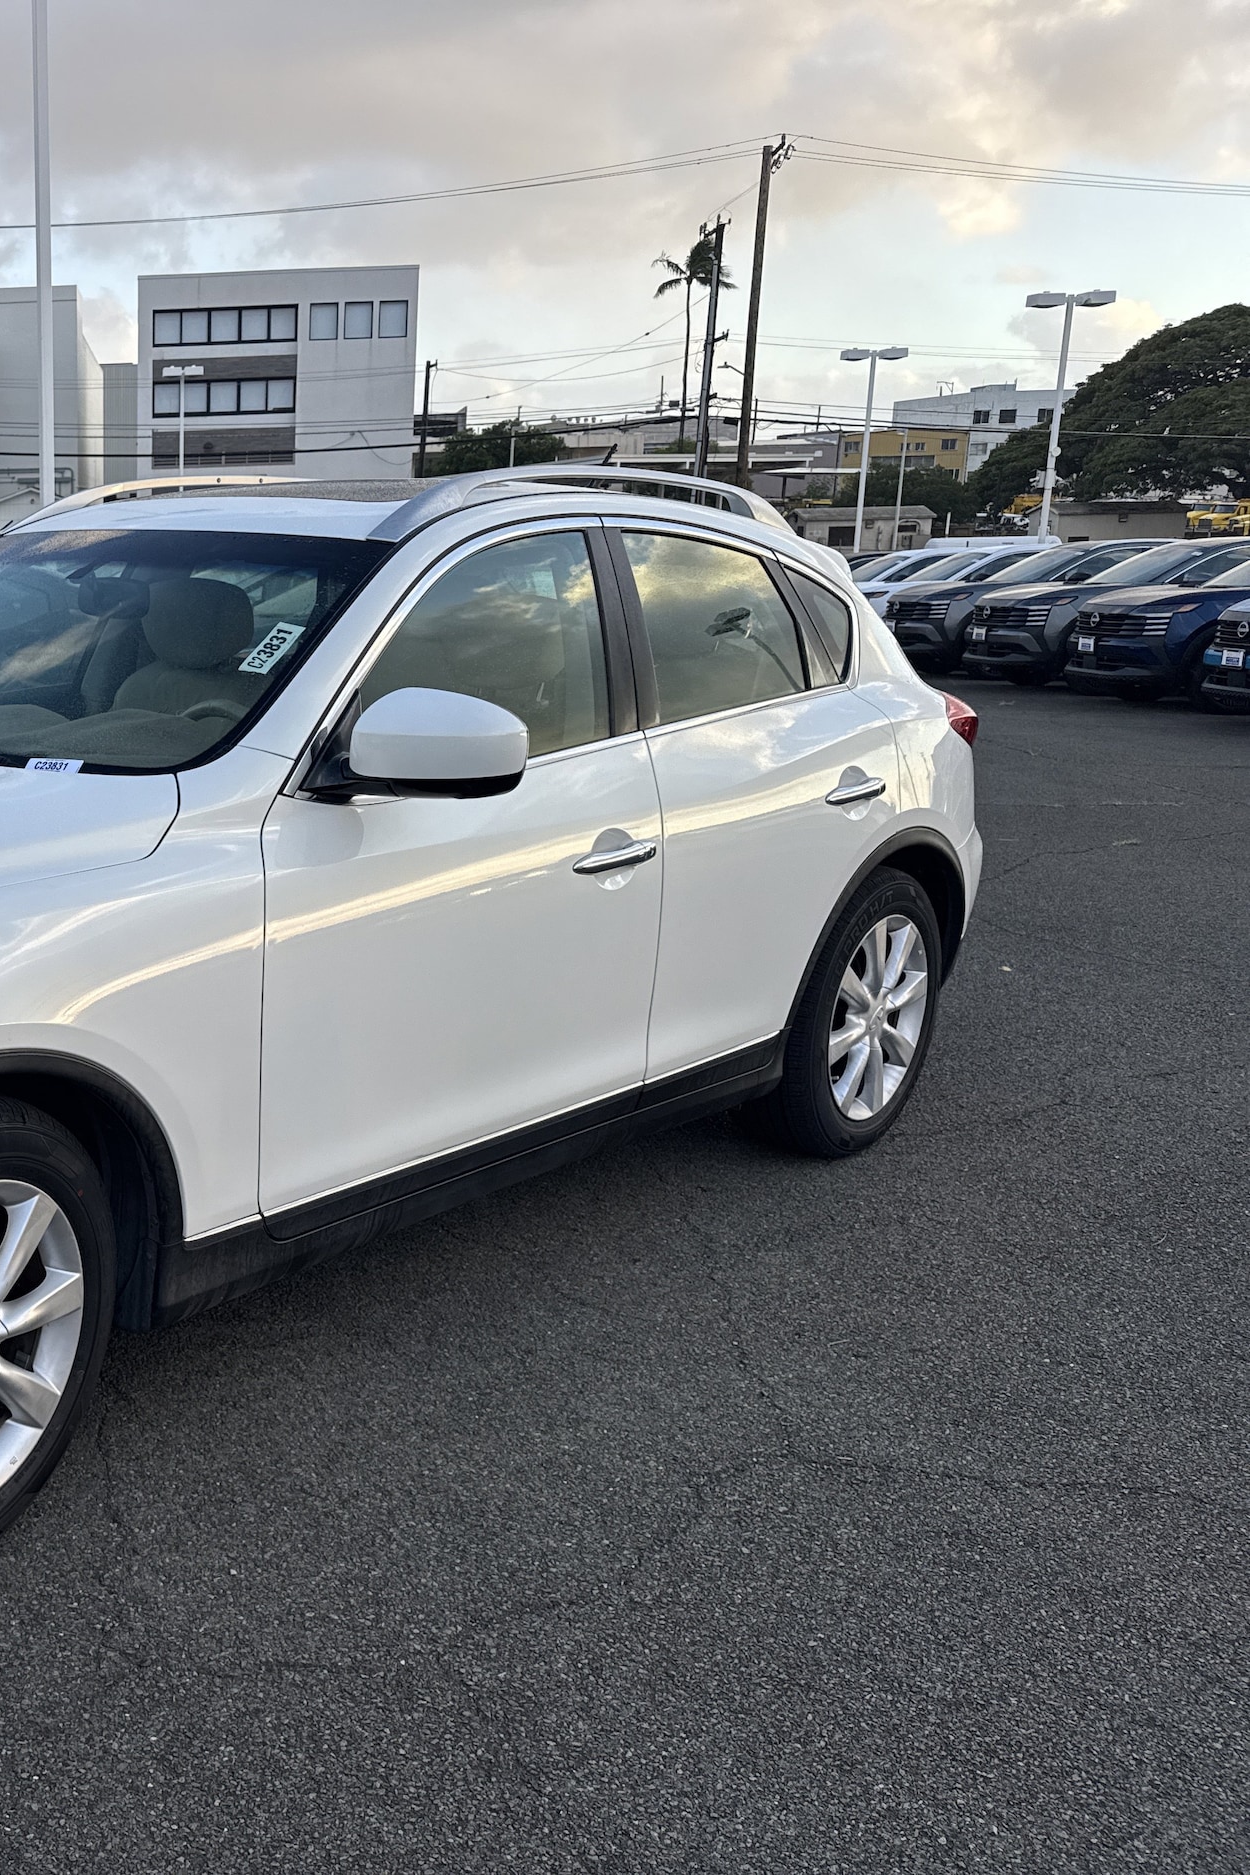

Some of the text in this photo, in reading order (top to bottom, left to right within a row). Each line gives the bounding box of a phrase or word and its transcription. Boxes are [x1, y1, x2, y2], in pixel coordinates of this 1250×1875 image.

[247, 628, 293, 669] C23831
[34, 761, 69, 771] C23831
[843, 913, 869, 957] PRO
[868, 889, 894, 918] H/T
